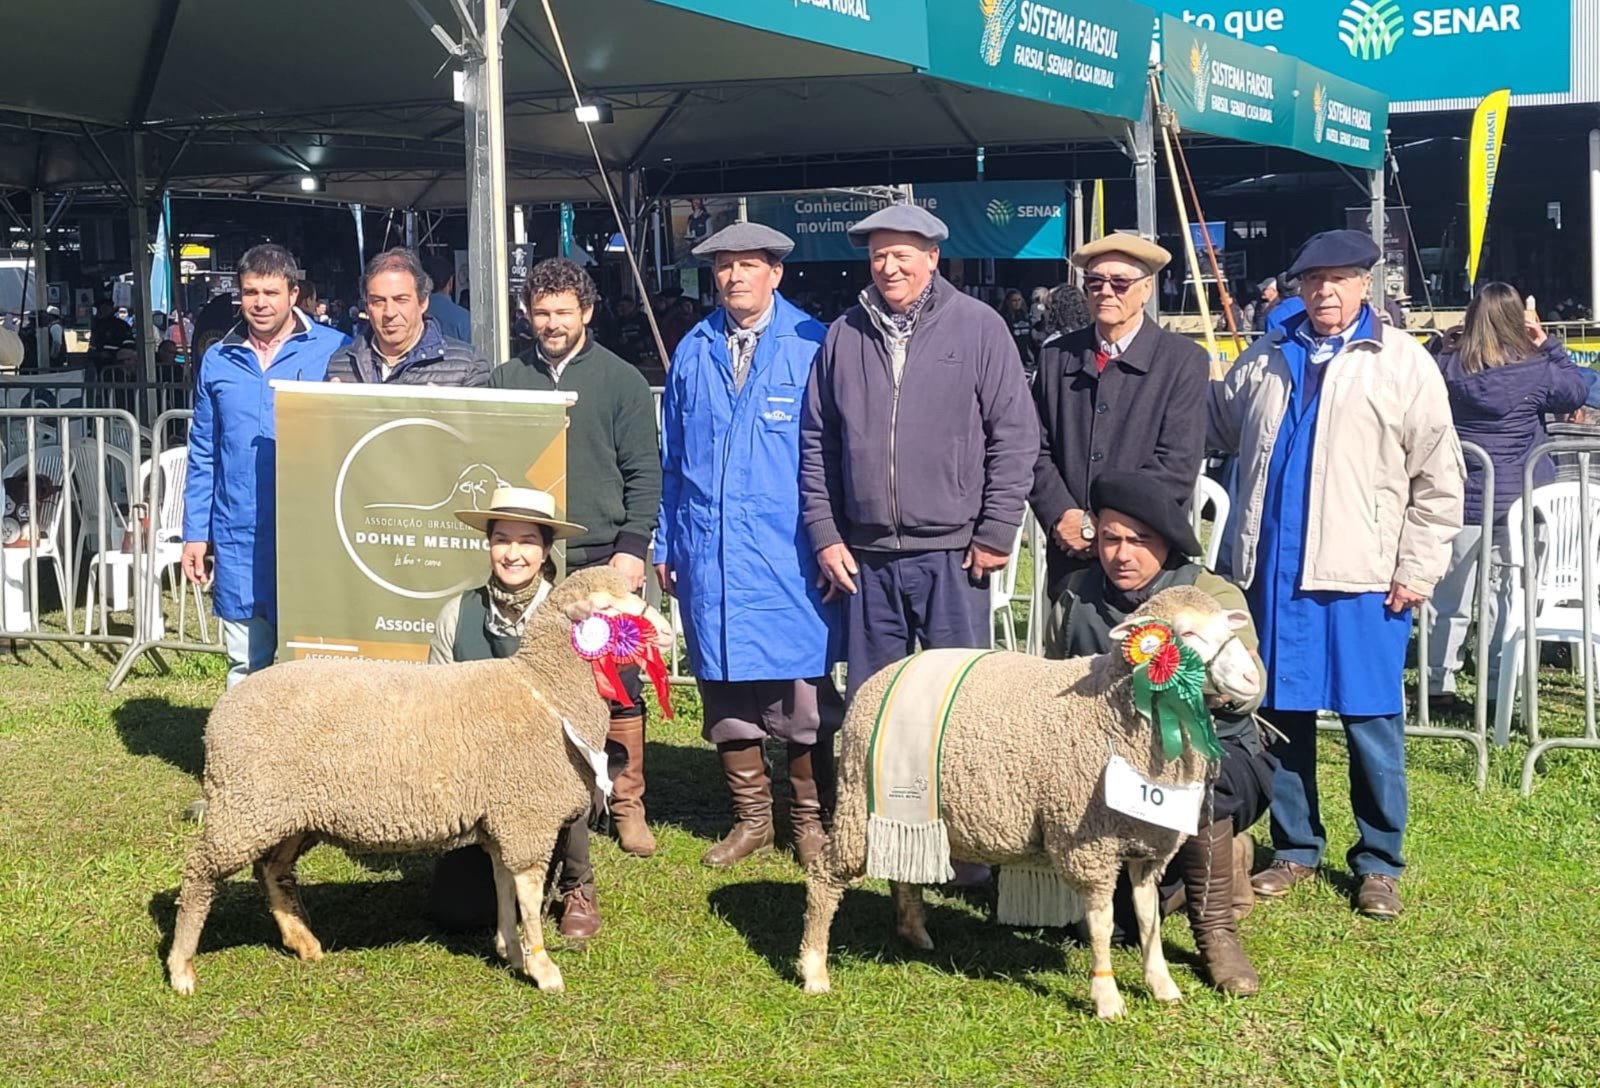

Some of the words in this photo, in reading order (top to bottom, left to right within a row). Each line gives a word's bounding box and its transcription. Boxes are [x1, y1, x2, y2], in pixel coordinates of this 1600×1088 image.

[1018, 0, 1075, 46] SISTEMA
[1076, 19, 1119, 59] FARSUL
[1224, 8, 1284, 39] que
[1411, 4, 1521, 37] SENAR
[1014, 45, 1045, 71] FARSUL
[1046, 53, 1073, 79] SENAR
[1075, 62, 1093, 83] CASA
[1093, 66, 1115, 88] RURAL
[1211, 60, 1246, 93] SISTEMA
[1246, 70, 1274, 100] FARSUL
[1485, 110, 1497, 151] BRASIL
[794, 196, 888, 214] Conhecimen
[1017, 205, 1062, 218] SENAR
[364, 517, 423, 529] ASSOCIAÇÃO
[356, 532, 416, 547] DOHNE
[375, 616, 435, 633] Associe
[1140, 784, 1164, 806] 10
